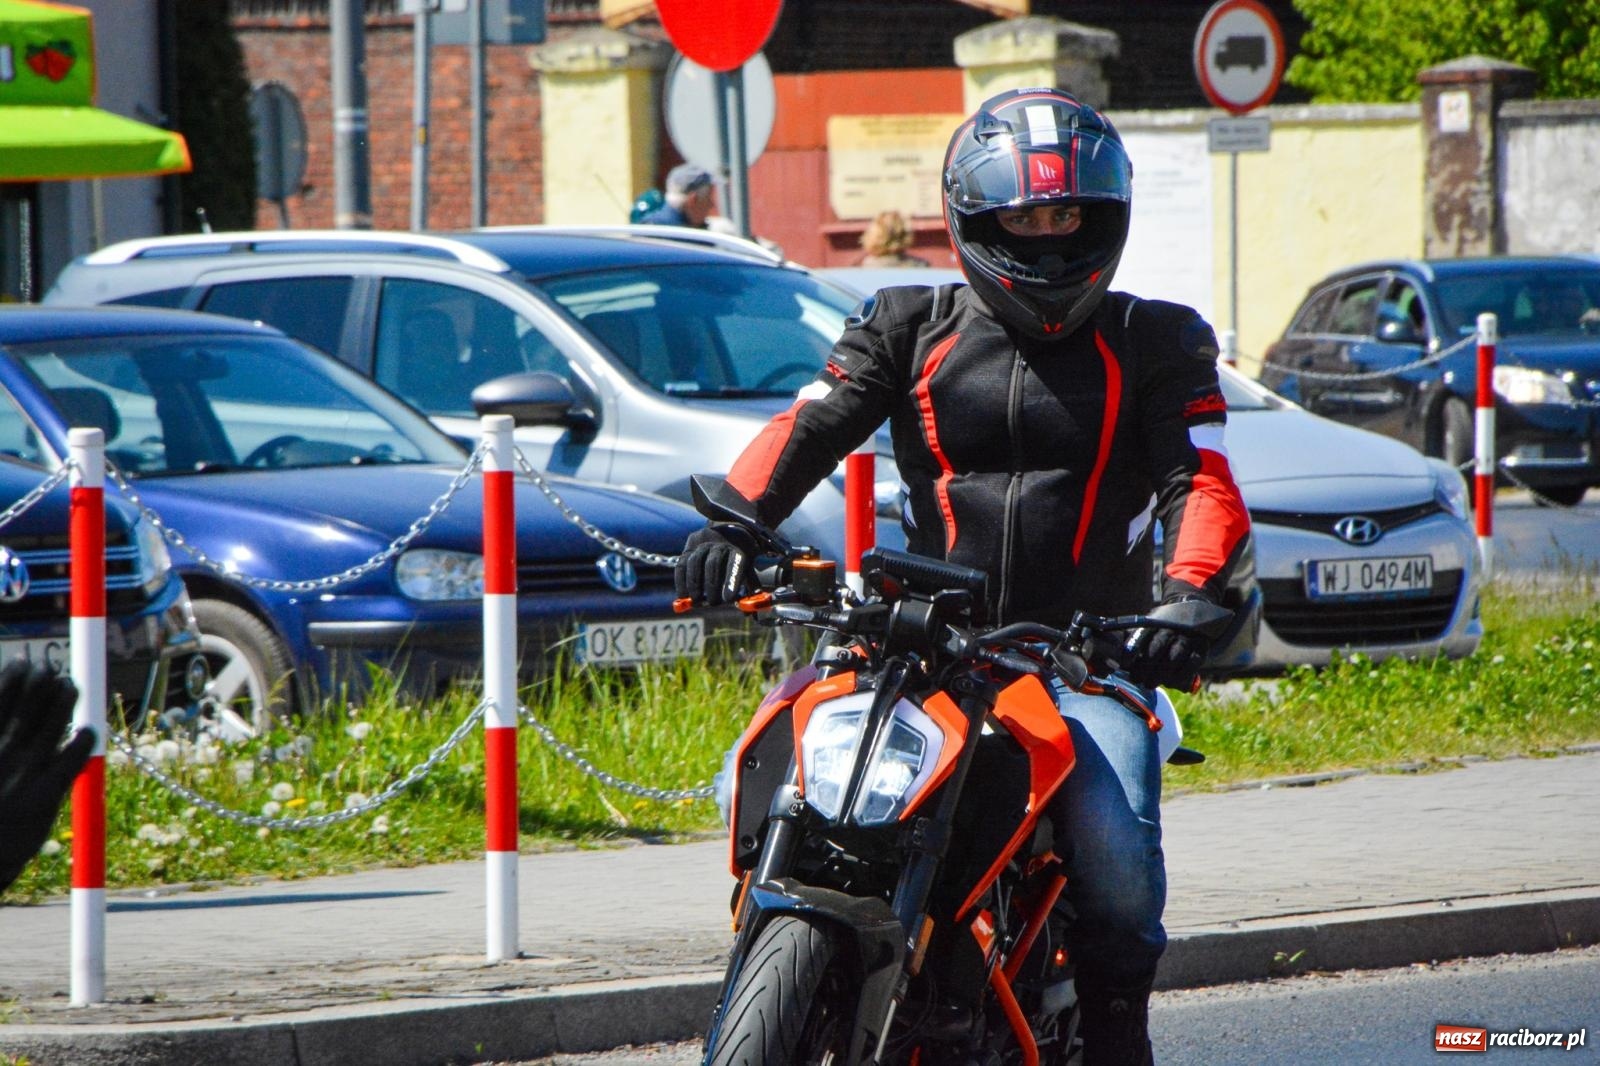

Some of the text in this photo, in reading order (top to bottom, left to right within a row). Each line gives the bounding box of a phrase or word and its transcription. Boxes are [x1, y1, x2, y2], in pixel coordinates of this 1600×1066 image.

[1322, 560, 1427, 592] WJ 0494M
[591, 622, 700, 657] OK 81202
